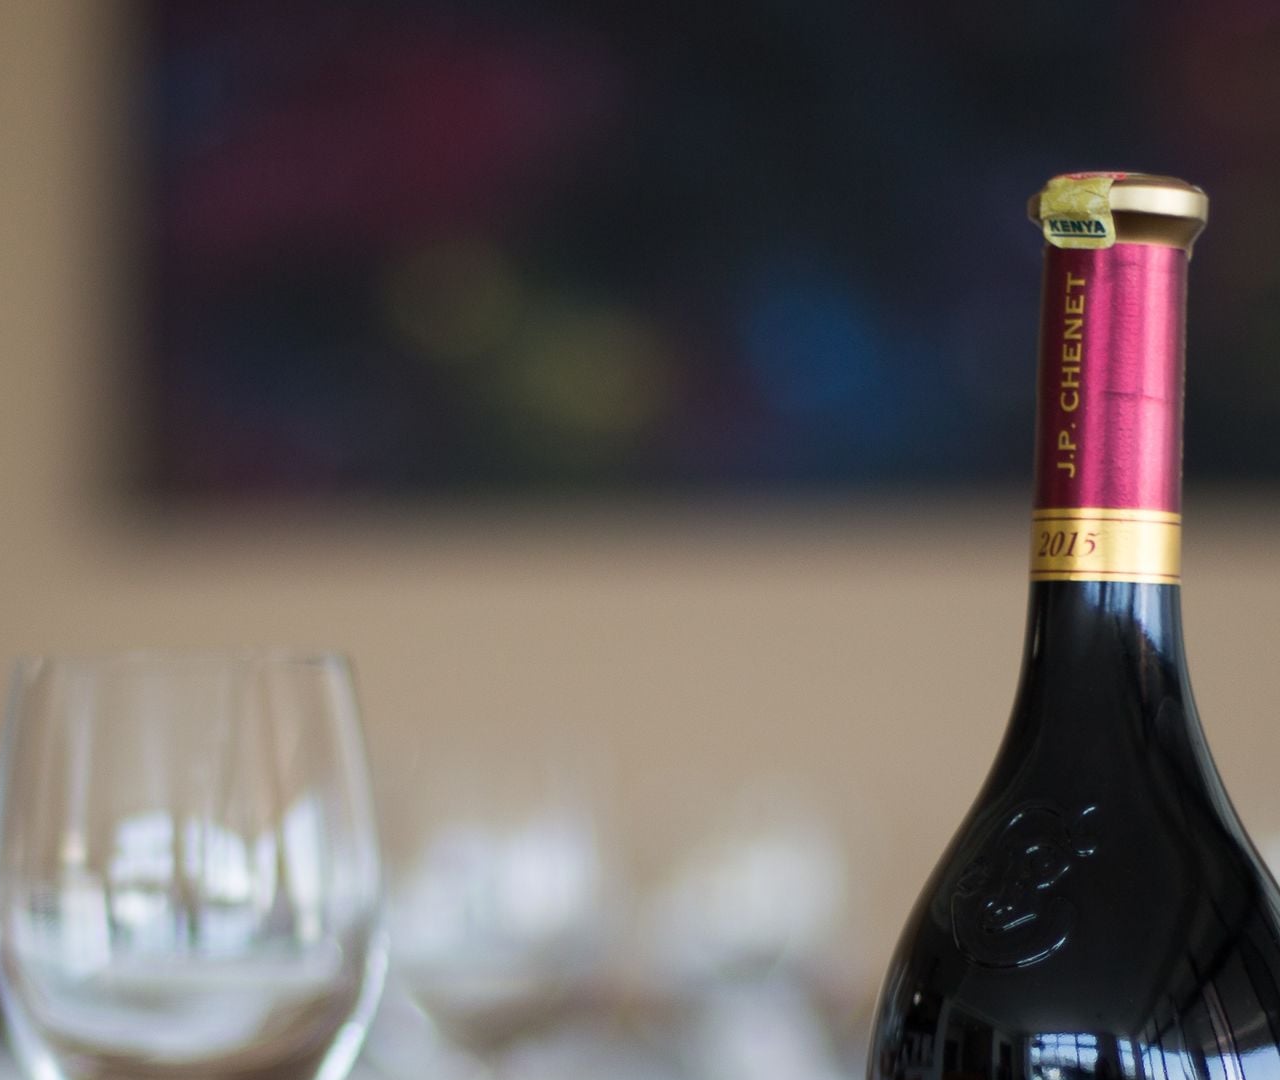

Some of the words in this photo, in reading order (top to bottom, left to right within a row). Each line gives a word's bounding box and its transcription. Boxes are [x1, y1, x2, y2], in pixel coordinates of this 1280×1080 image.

[1049, 220, 1106, 233] KENYA
[1060, 272, 1086, 412] CHENET
[1057, 421, 1077, 478] J.P.
[1039, 531, 1099, 557] 2015
